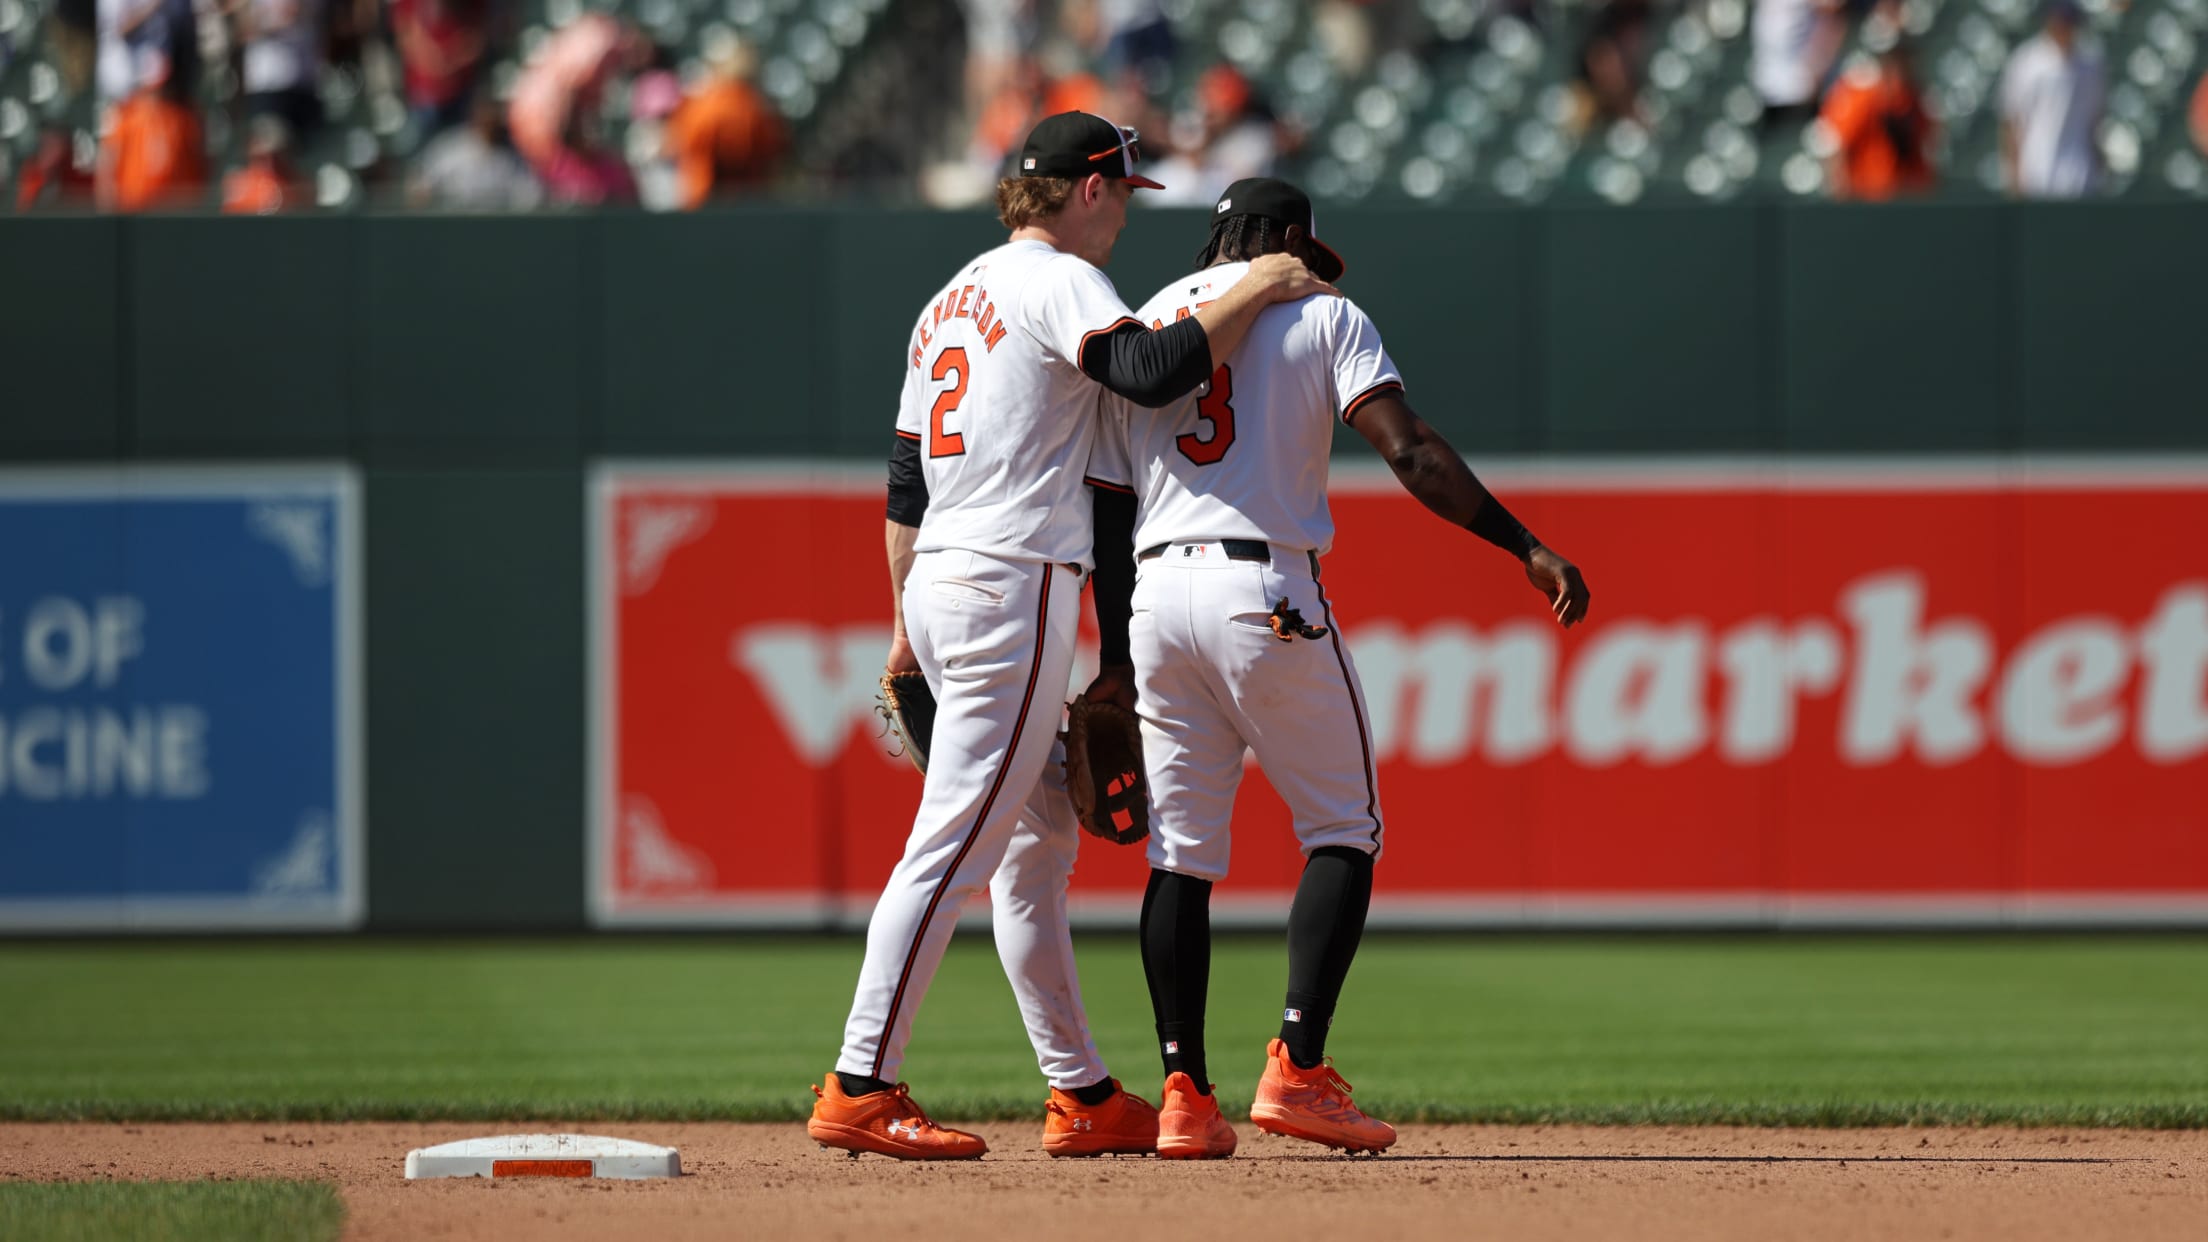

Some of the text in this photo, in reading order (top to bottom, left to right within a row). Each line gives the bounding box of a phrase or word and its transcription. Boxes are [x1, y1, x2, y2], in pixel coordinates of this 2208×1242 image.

[912, 285, 1008, 369] HENDESON
[930, 347, 970, 459] 2
[1176, 363, 1236, 467] 3
[24, 597, 146, 690] OF
[1346, 570, 2208, 766] market
